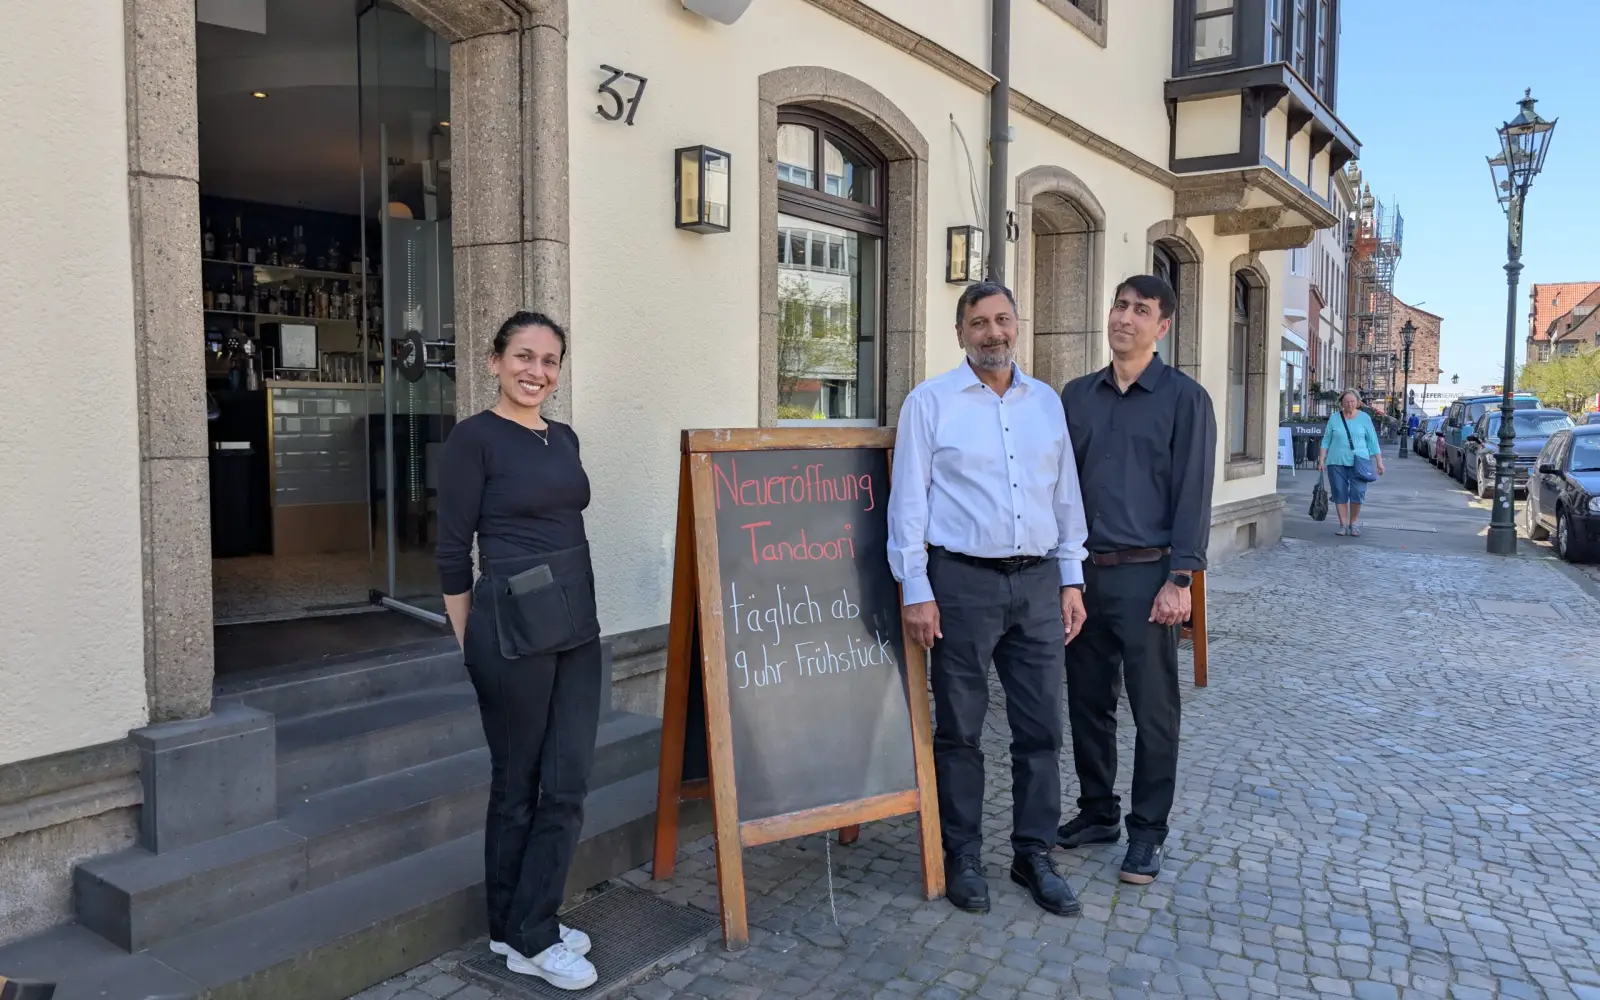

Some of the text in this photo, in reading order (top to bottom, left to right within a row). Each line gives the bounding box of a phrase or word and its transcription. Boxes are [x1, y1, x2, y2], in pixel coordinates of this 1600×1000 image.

[596, 64, 648, 126] 37
[1296, 426, 1322, 434] Thalia
[713, 458, 875, 511] Neueröffnung
[741, 520, 855, 565] Tandoori
[729, 582, 860, 646] täglich ab
[795, 629, 893, 677] Frühstück
